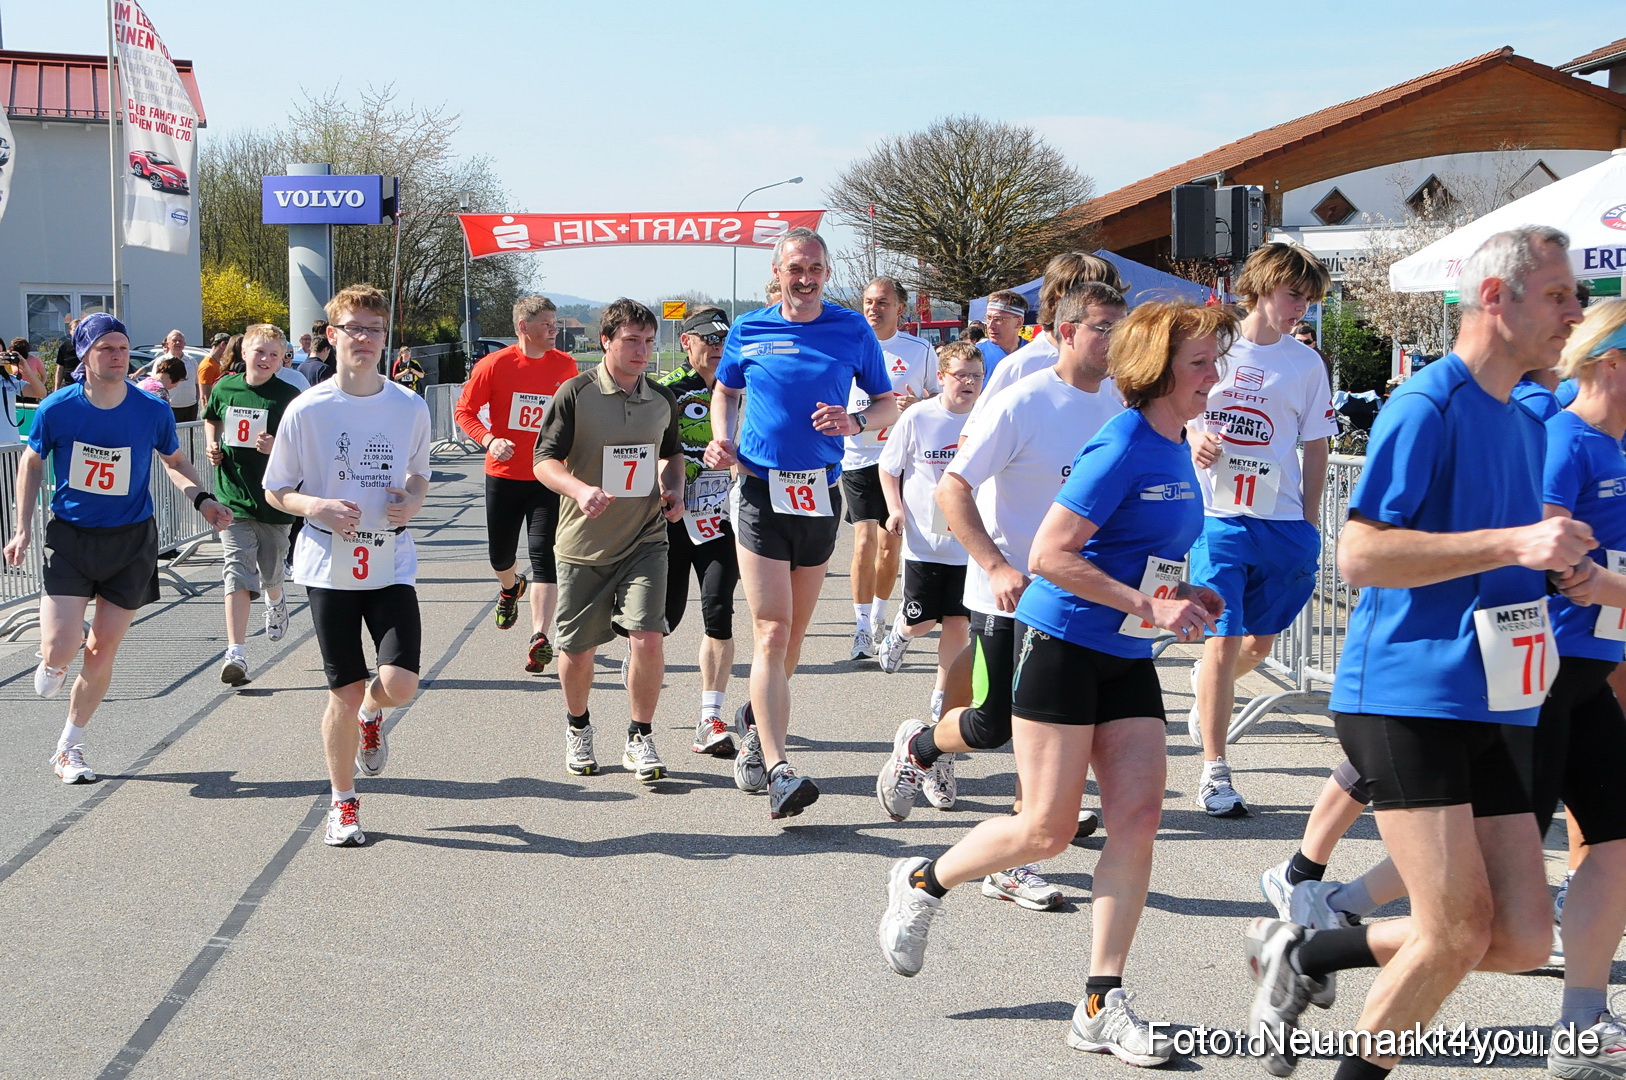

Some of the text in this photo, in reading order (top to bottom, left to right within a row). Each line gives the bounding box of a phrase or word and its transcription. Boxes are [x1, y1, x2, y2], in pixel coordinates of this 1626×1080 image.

[114, 2, 131, 22] IM
[115, 23, 155, 51] EINEN
[180, 116, 194, 129] SIE
[175, 128, 192, 142] C70.
[274, 190, 365, 207] VOLVO
[1222, 390, 1268, 404] SEAT
[518, 405, 544, 429] 62
[1203, 410, 1263, 430] GERHART
[237, 419, 250, 442] 8
[82, 445, 110, 457] MEYER
[82, 451, 110, 461] WERBUNG
[613, 447, 638, 455] MEYER
[923, 450, 955, 459] GERH
[1228, 464, 1257, 473] WERBUNG
[1229, 457, 1257, 468] MEYER
[84, 459, 115, 490] 75
[338, 470, 392, 481] 9. Neumarkter
[623, 460, 638, 491] 7
[778, 470, 807, 480] MEYER
[778, 477, 807, 485] WERBUNG
[360, 480, 392, 488] Stadtlauf
[1233, 473, 1257, 507] 11
[785, 485, 816, 512] 13
[696, 515, 722, 539] 55
[342, 537, 374, 545] WERBUNG
[352, 545, 370, 580] 3
[1496, 605, 1540, 625] MEYER
[1512, 632, 1547, 696] 77
